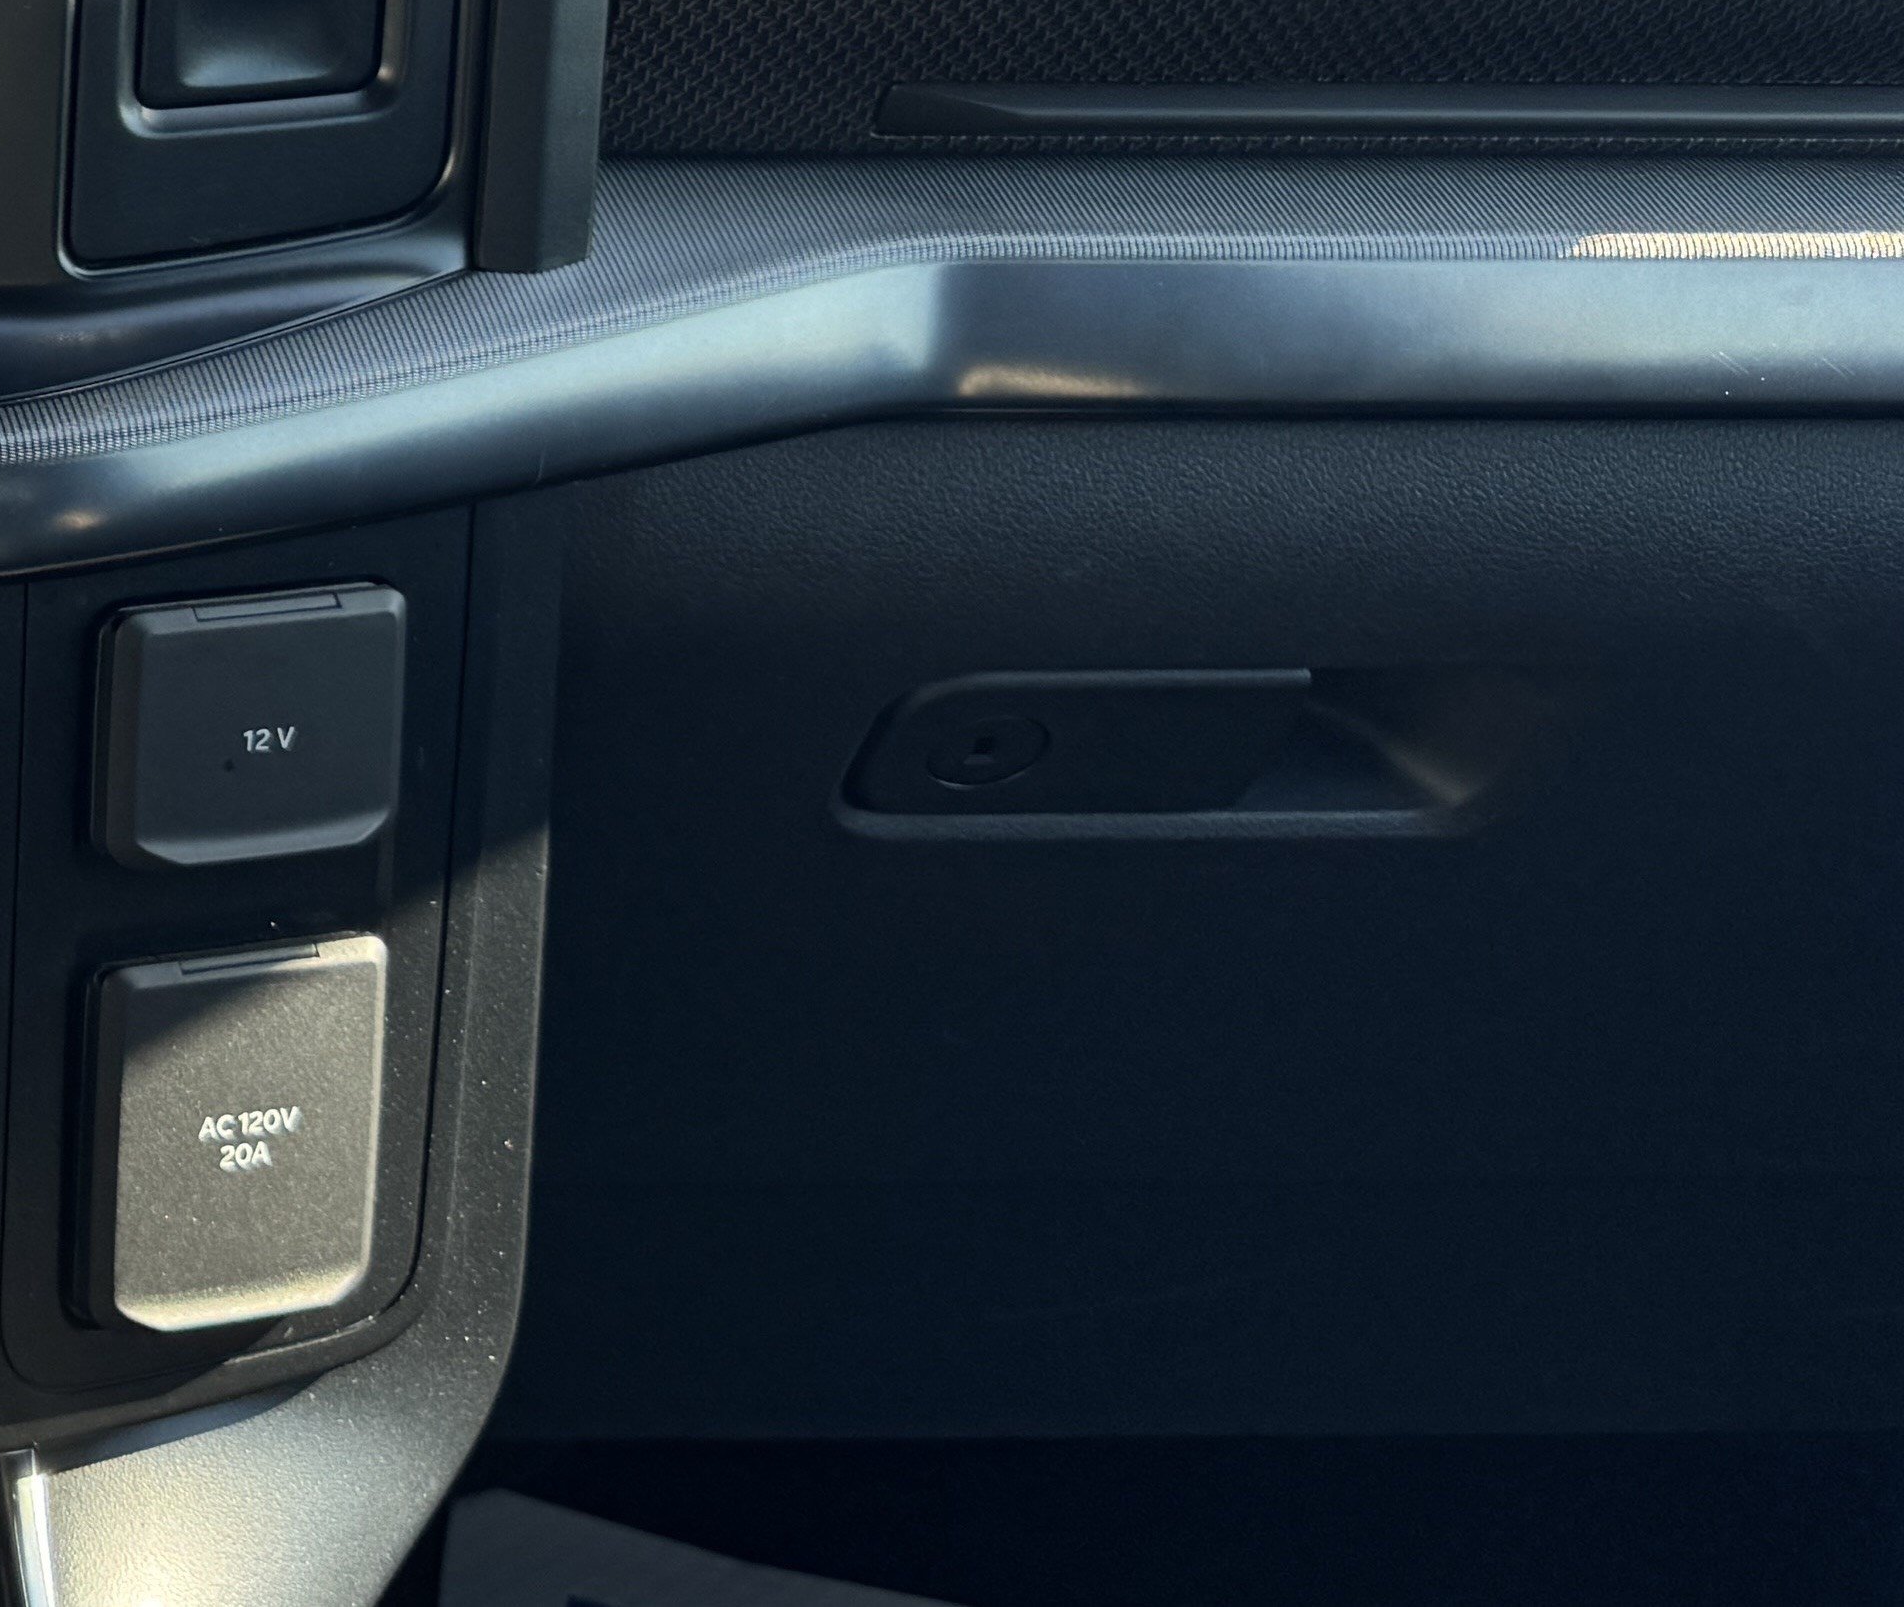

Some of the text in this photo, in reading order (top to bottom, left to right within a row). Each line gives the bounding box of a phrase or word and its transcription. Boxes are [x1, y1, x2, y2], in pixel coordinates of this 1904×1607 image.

[243, 727, 297, 752] 12 V
[198, 1107, 302, 1141] AC 120V
[220, 1143, 272, 1170] 20A
